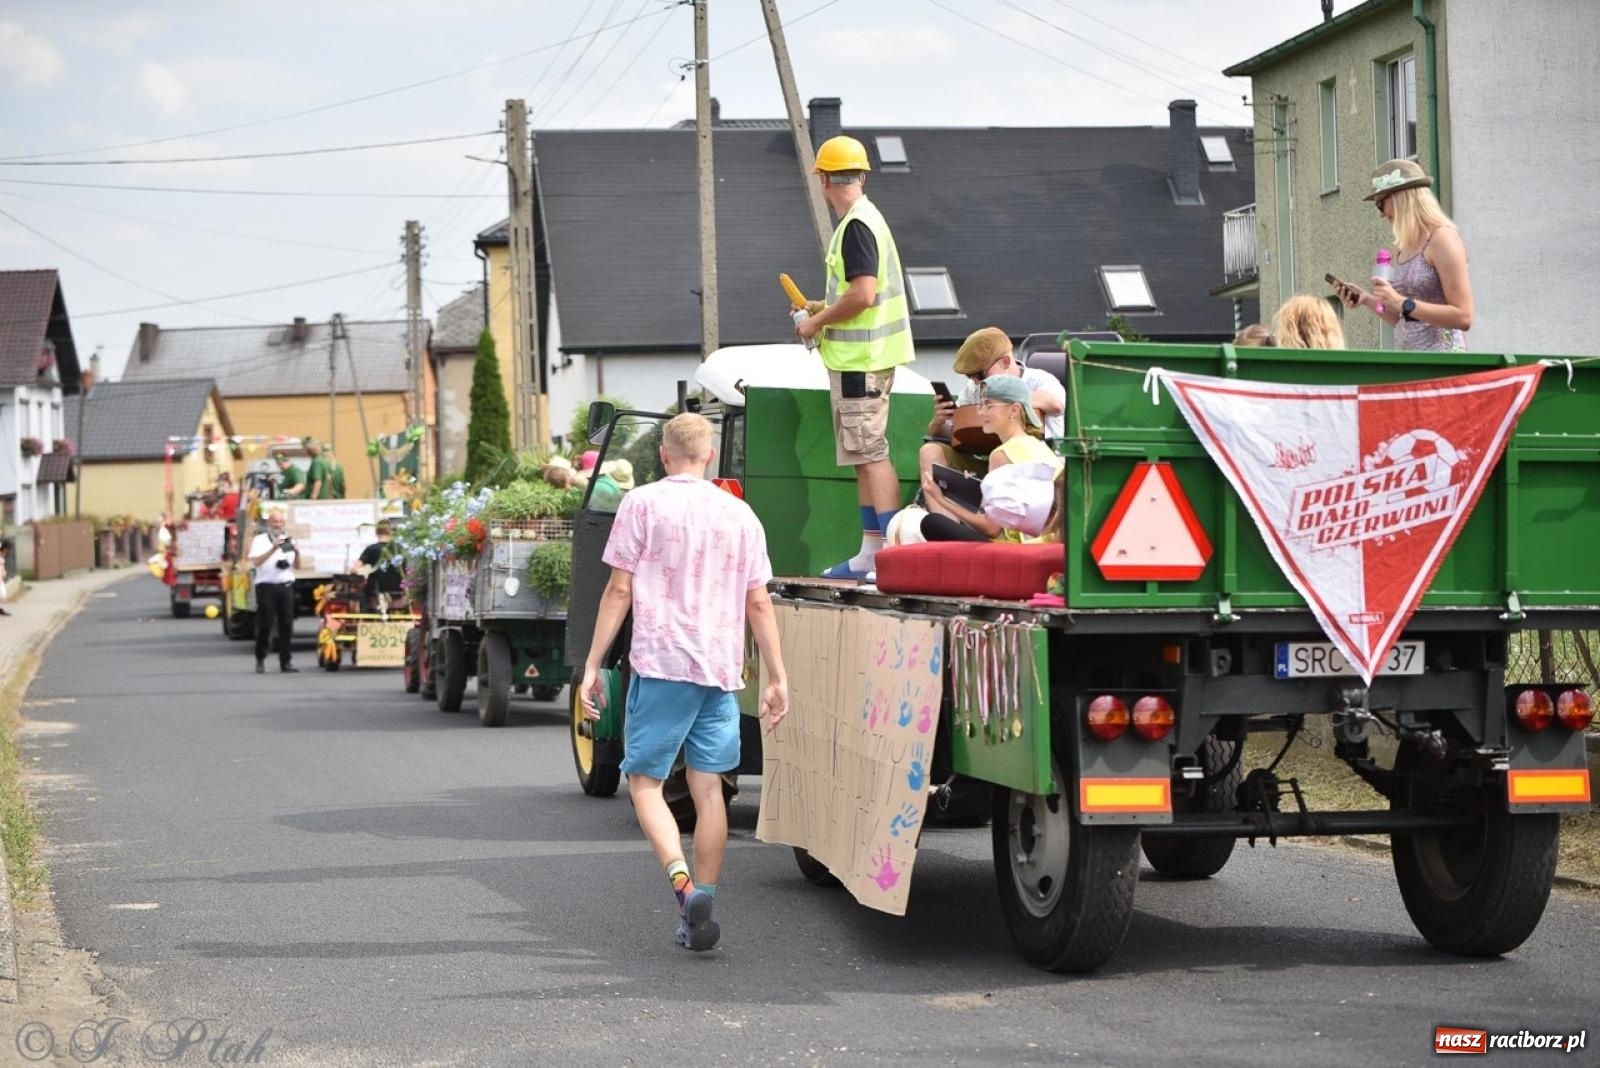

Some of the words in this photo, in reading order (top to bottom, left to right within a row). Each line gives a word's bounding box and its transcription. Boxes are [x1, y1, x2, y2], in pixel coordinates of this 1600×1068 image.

[1301, 462, 1428, 511] POLSKA
[1297, 500, 1371, 531] BIAŁO
[1317, 494, 1450, 545] CZERWONI
[1294, 646, 1343, 674] SRC
